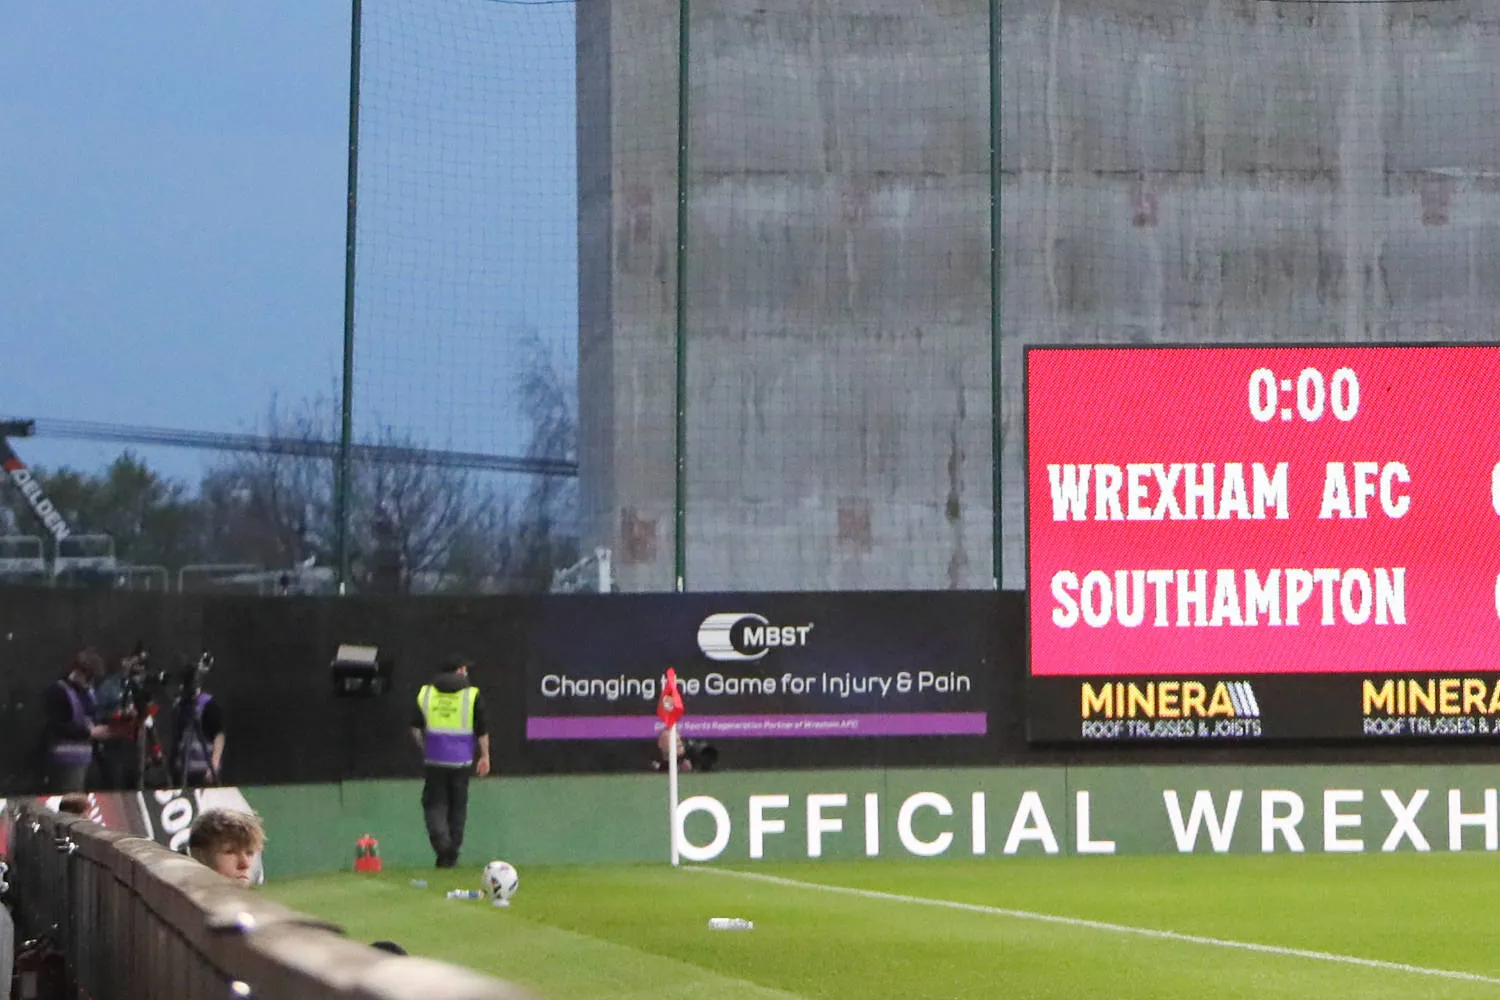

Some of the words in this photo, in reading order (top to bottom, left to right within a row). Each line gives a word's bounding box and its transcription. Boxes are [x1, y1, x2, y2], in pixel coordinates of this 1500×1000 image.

[1248, 366, 1361, 422] 0:00
[1047, 461, 1290, 521] WREXHAM
[1318, 460, 1411, 519] AFC
[1050, 567, 1407, 628] SOUTHAMPTON
[743, 625, 810, 647] MBST
[541, 674, 656, 701] Changing
[704, 673, 776, 695] Game
[781, 672, 816, 694] for
[822, 672, 892, 697] Injury
[897, 671, 912, 692] &
[918, 671, 971, 692] Pain
[1081, 680, 1235, 718] MINERA
[1082, 719, 1124, 738] ROOF
[1127, 719, 1195, 738] TRUSSES
[1211, 719, 1262, 737] JOISTS
[1363, 716, 1406, 736] ROOF
[1408, 716, 1475, 735] TRUSSES
[675, 790, 1116, 861] OFFICIAL
